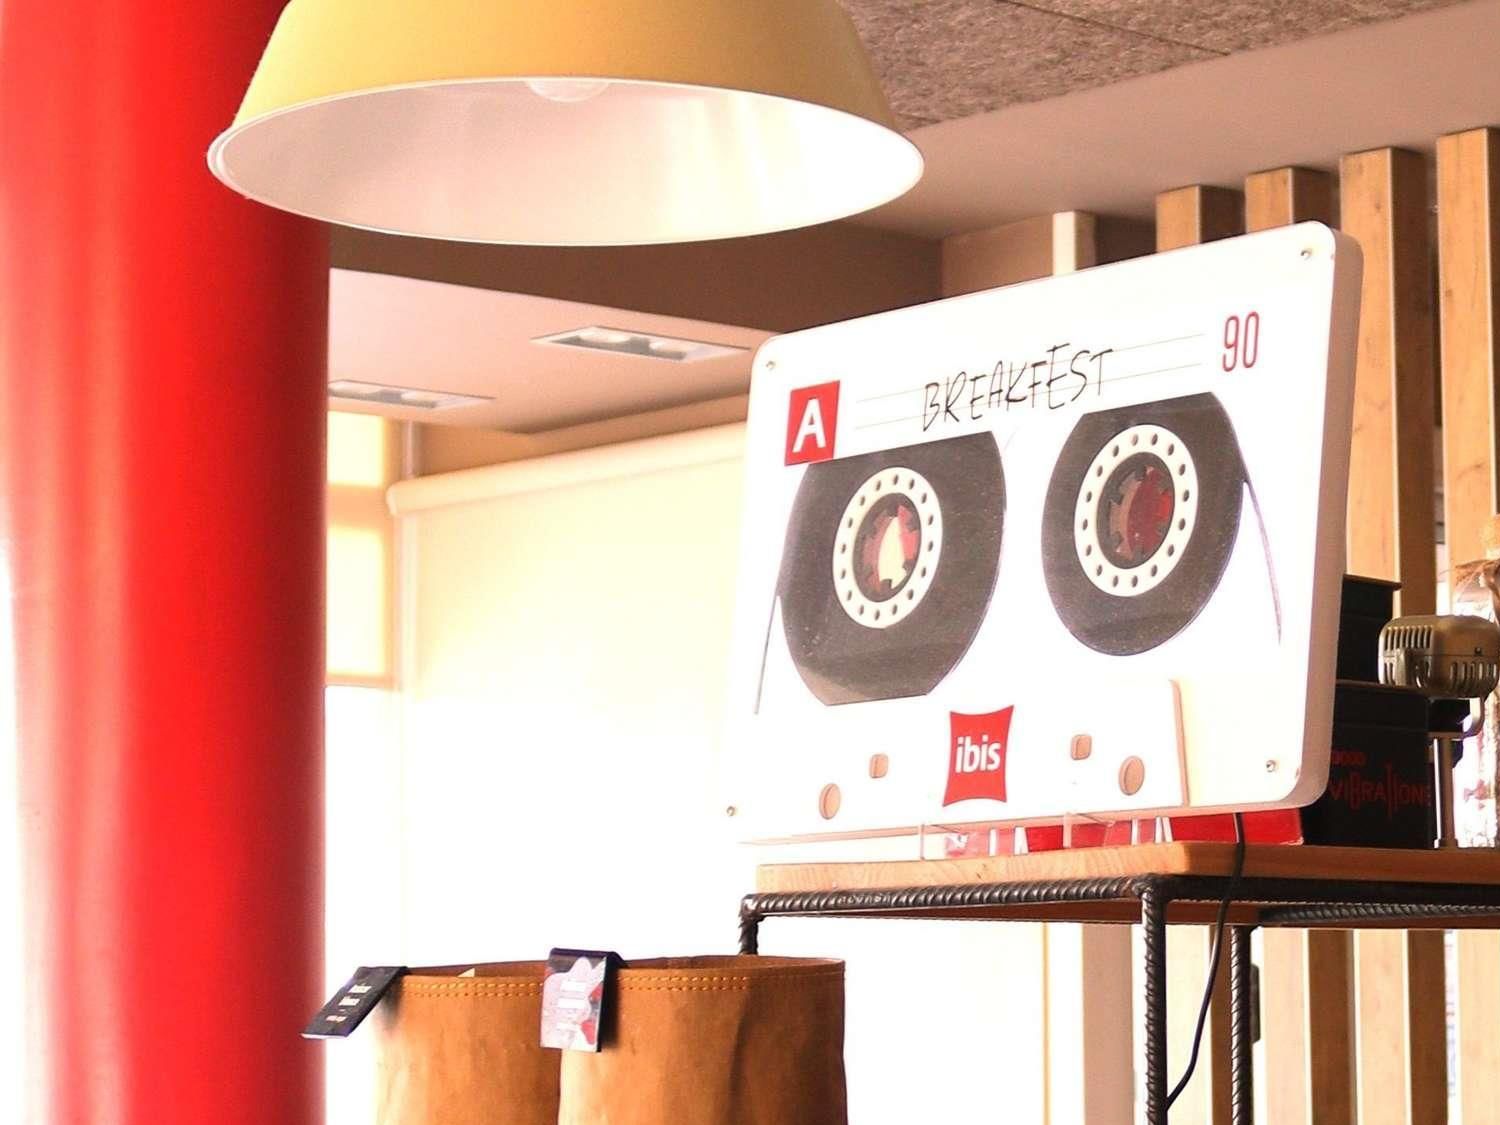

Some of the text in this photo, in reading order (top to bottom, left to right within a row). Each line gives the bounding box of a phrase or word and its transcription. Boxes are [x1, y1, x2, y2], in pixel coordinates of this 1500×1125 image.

[1222, 311, 1261, 372] 90
[921, 342, 1114, 432] BREAKFEST
[794, 398, 827, 452] A
[955, 735, 1002, 774] ibis
